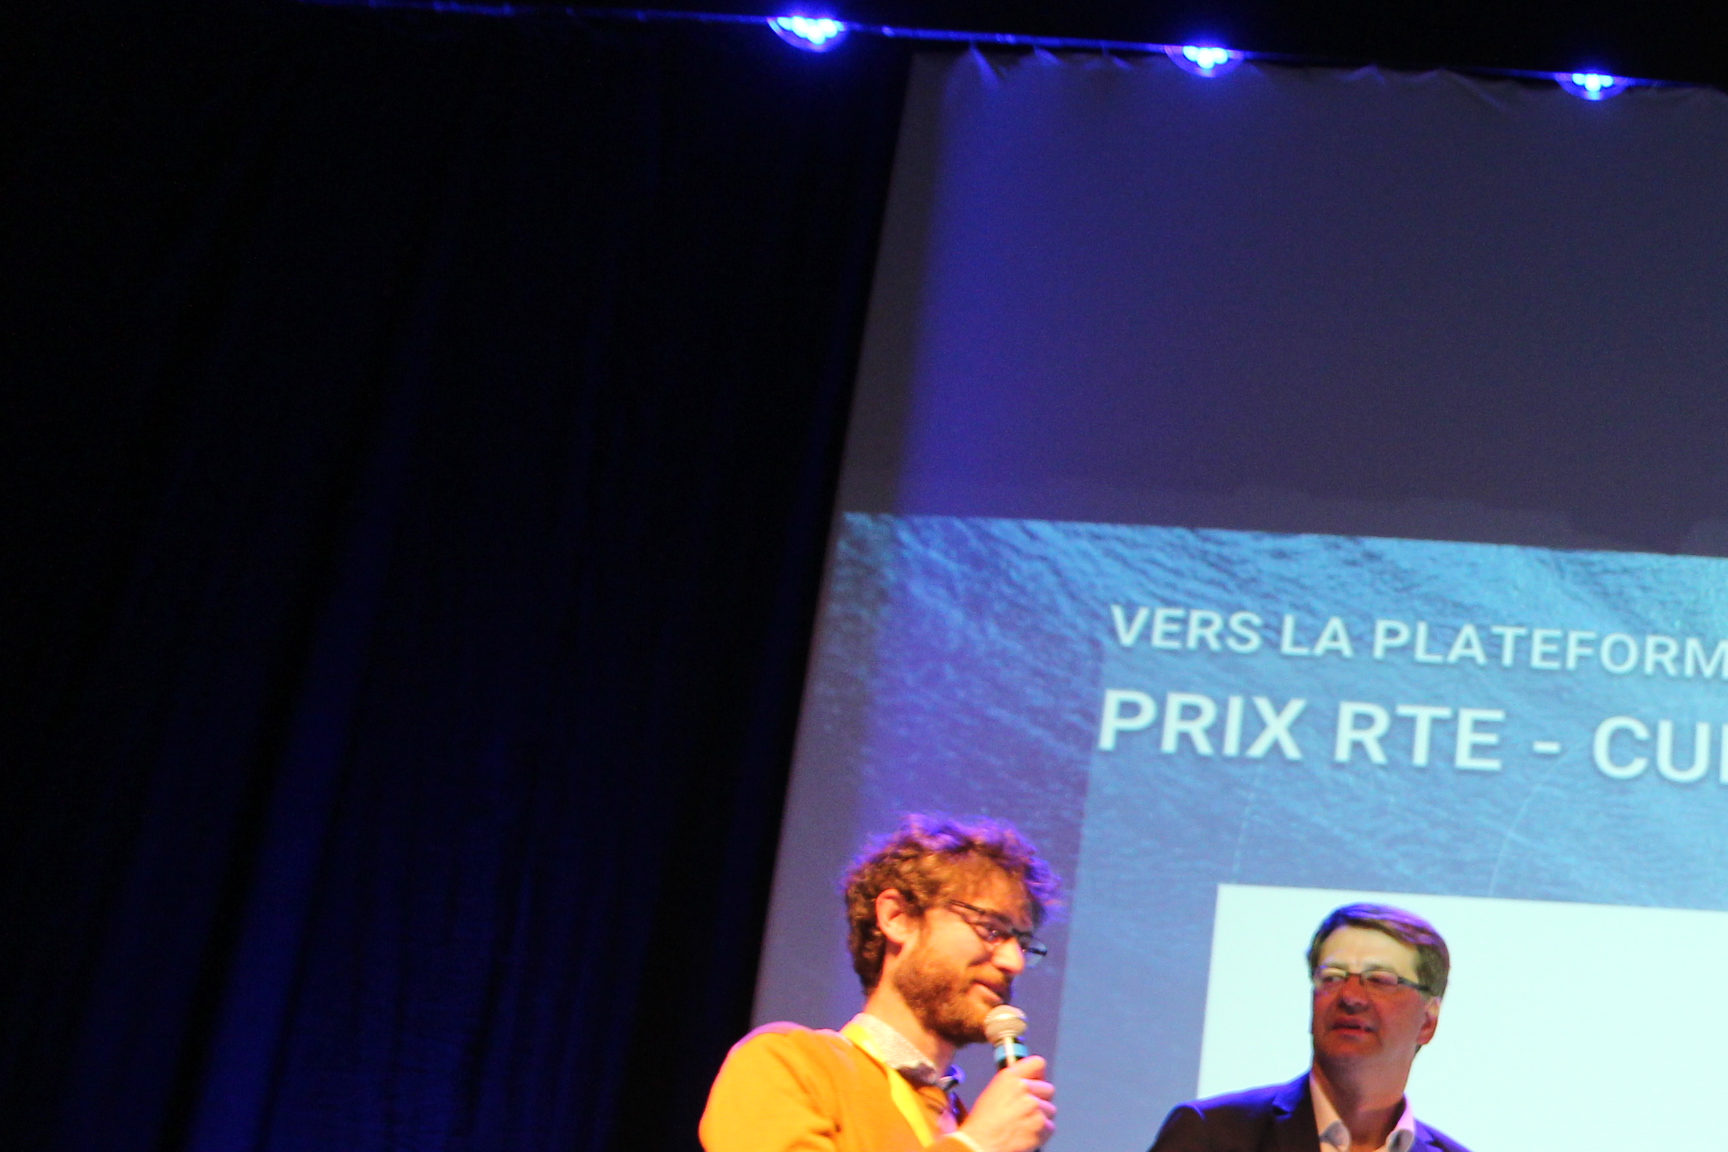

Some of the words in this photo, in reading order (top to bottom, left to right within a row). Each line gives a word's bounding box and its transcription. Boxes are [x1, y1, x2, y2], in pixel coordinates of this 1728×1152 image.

[1111, 604, 1263, 652] VERS
[1280, 613, 1353, 658] LA
[1099, 688, 1305, 759] PRIX
[1334, 700, 1506, 770] RTE
[1533, 740, 1560, 753] -
